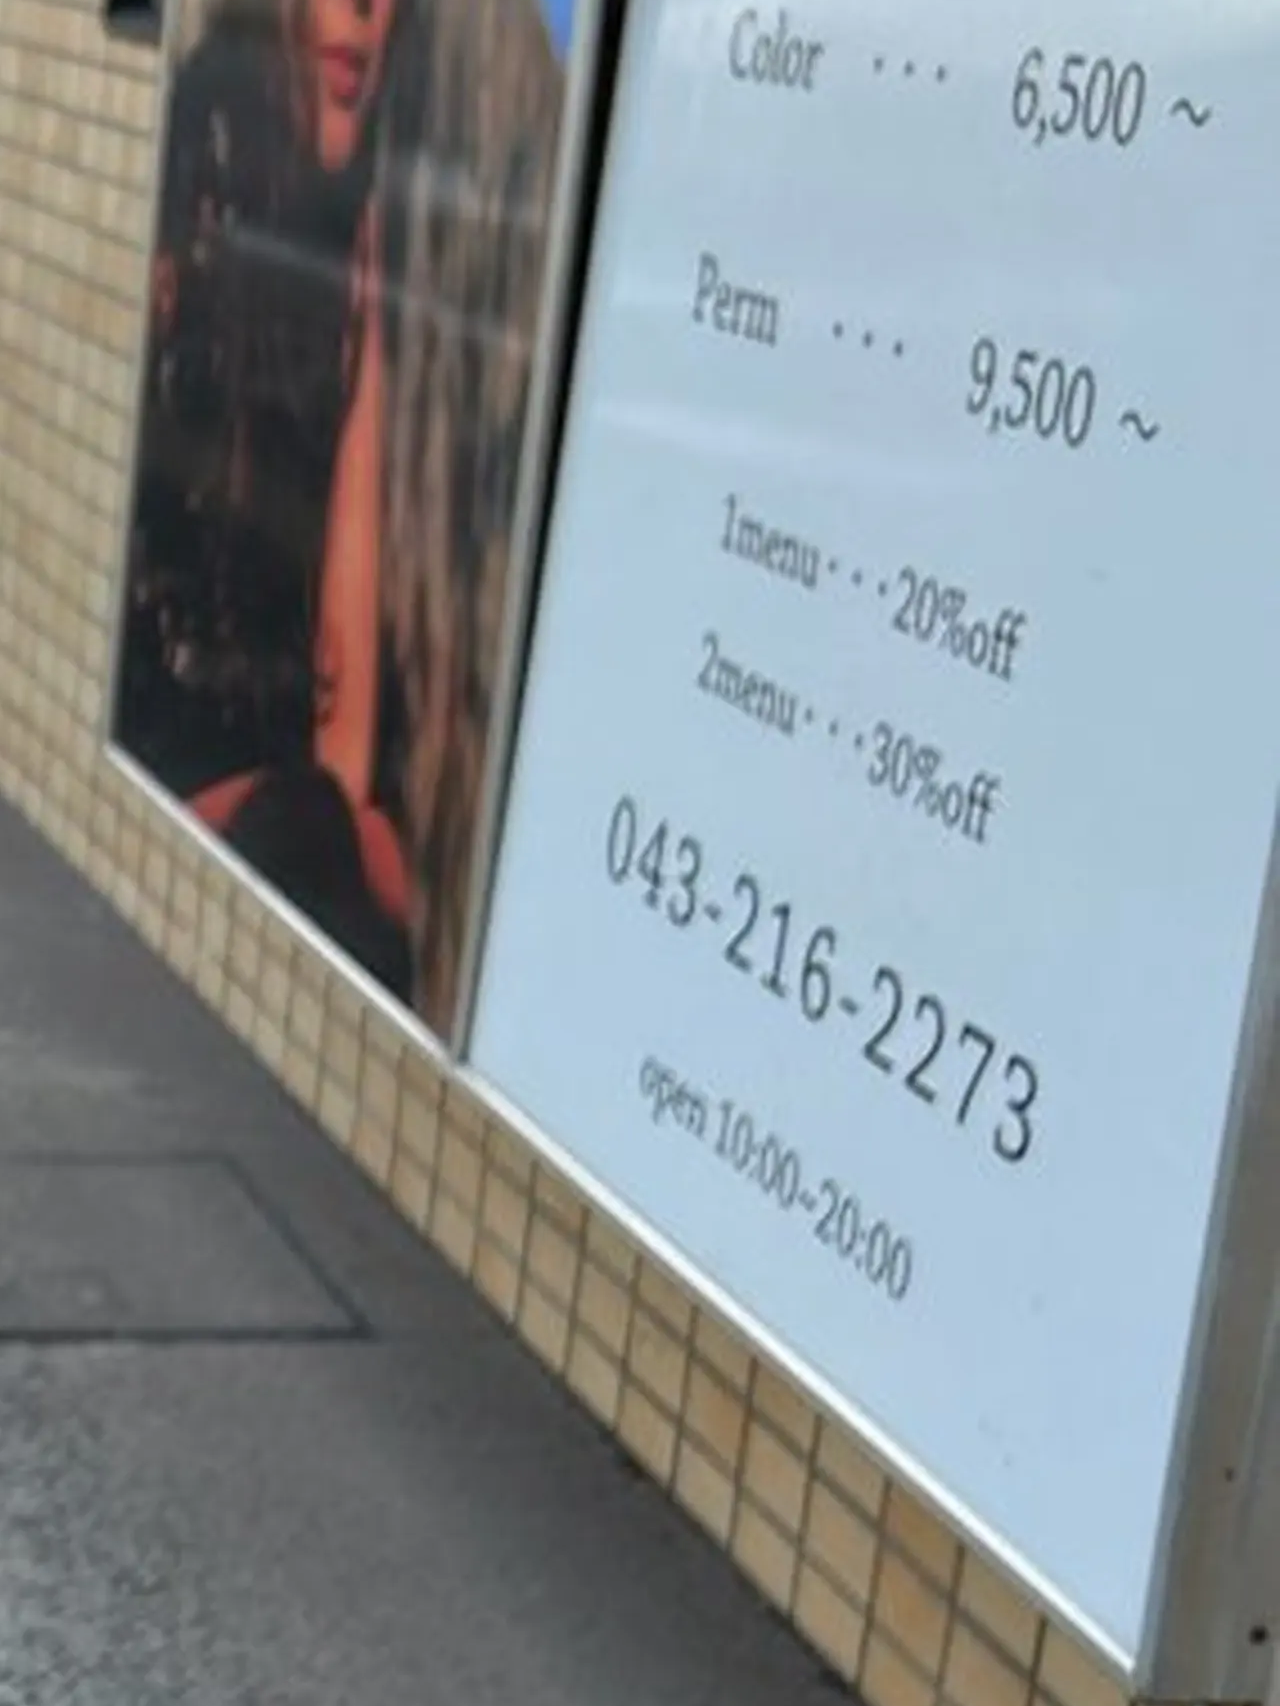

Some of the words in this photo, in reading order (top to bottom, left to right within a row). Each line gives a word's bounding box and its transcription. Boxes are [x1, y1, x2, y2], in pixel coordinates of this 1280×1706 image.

[728, 7, 824, 93] Color
[1011, 45, 1148, 148] 6,500
[690, 251, 780, 348] Perm
[965, 336, 1097, 450] 9,500
[606, 794, 1040, 1165] 043-216-2273
[639, 1056, 708, 1141] open
